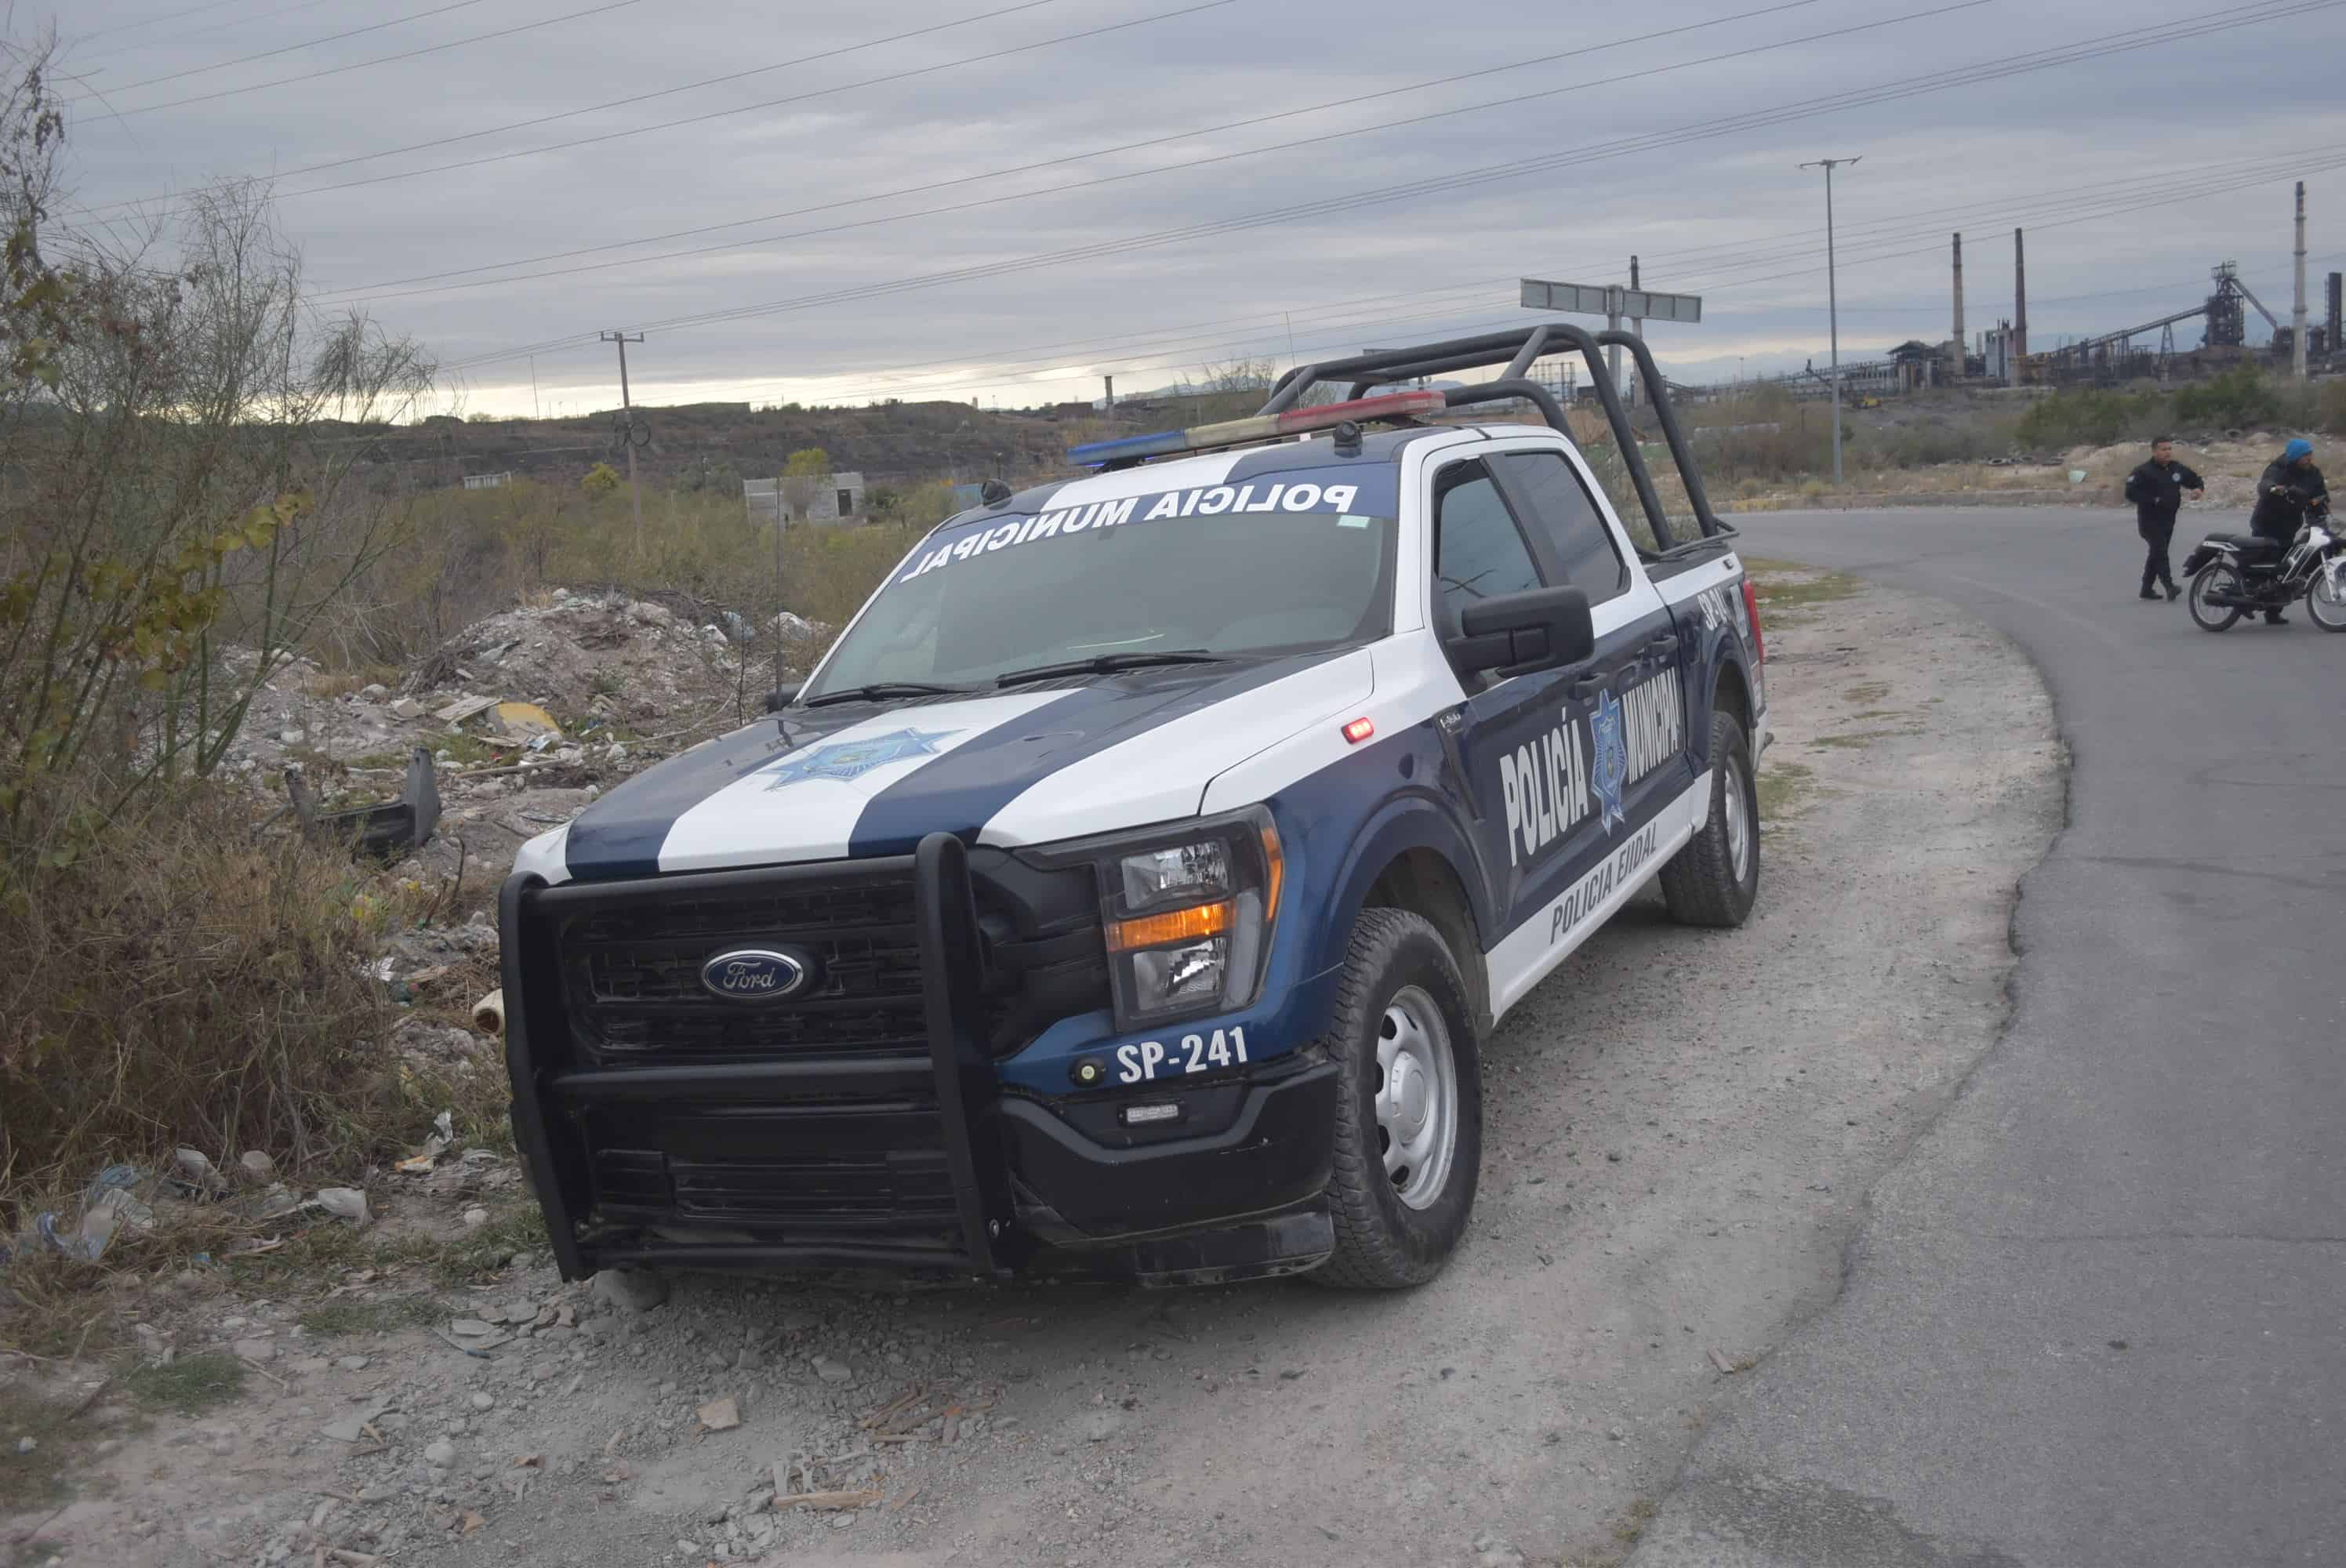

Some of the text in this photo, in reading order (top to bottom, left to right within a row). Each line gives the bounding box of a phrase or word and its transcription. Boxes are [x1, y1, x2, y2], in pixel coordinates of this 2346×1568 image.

[1499, 706, 1589, 867] POLICÍA
[1550, 862, 1613, 946] POLICIA
[722, 961, 776, 989] Ford
[1117, 1026, 1248, 1083] SP-241
